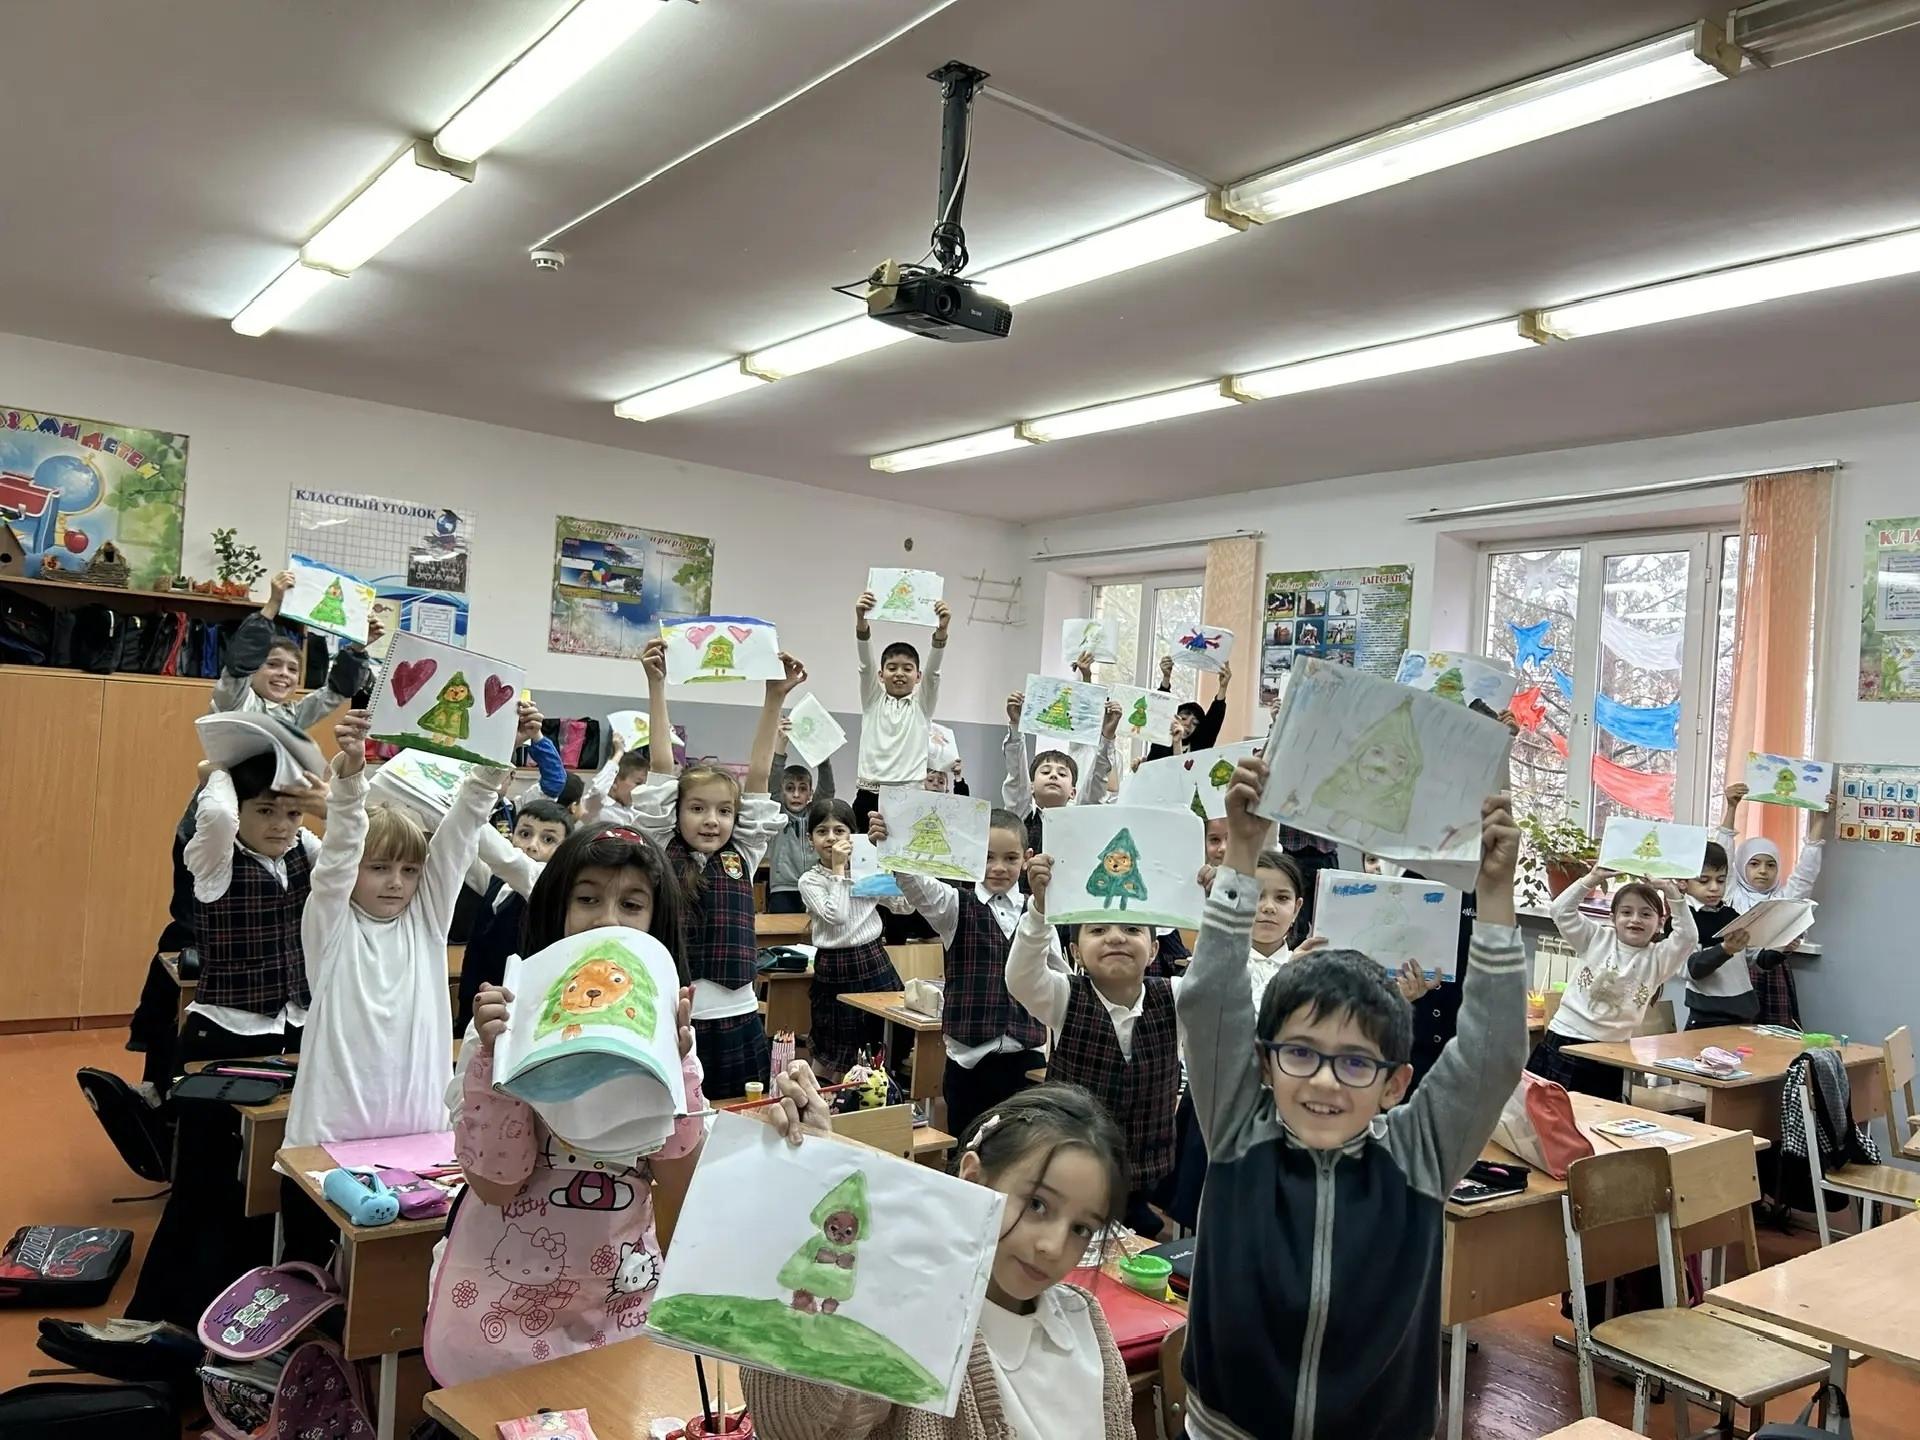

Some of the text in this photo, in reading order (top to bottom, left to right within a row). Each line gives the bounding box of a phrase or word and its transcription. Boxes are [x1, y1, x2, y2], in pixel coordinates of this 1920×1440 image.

[295, 489, 436, 519] КЛАССНЫЙ УГОЛОК
[1848, 784, 1914, 798] 0 1 2 3
[1863, 806, 1915, 818] 11 12 13
[1847, 827, 1855, 837] 0
[1868, 828, 1880, 839] 10
[1891, 831, 1905, 841] 20
[502, 1196, 549, 1222] Kitty
[606, 1296, 642, 1317] Hello
[617, 1311, 649, 1331] Kitt
